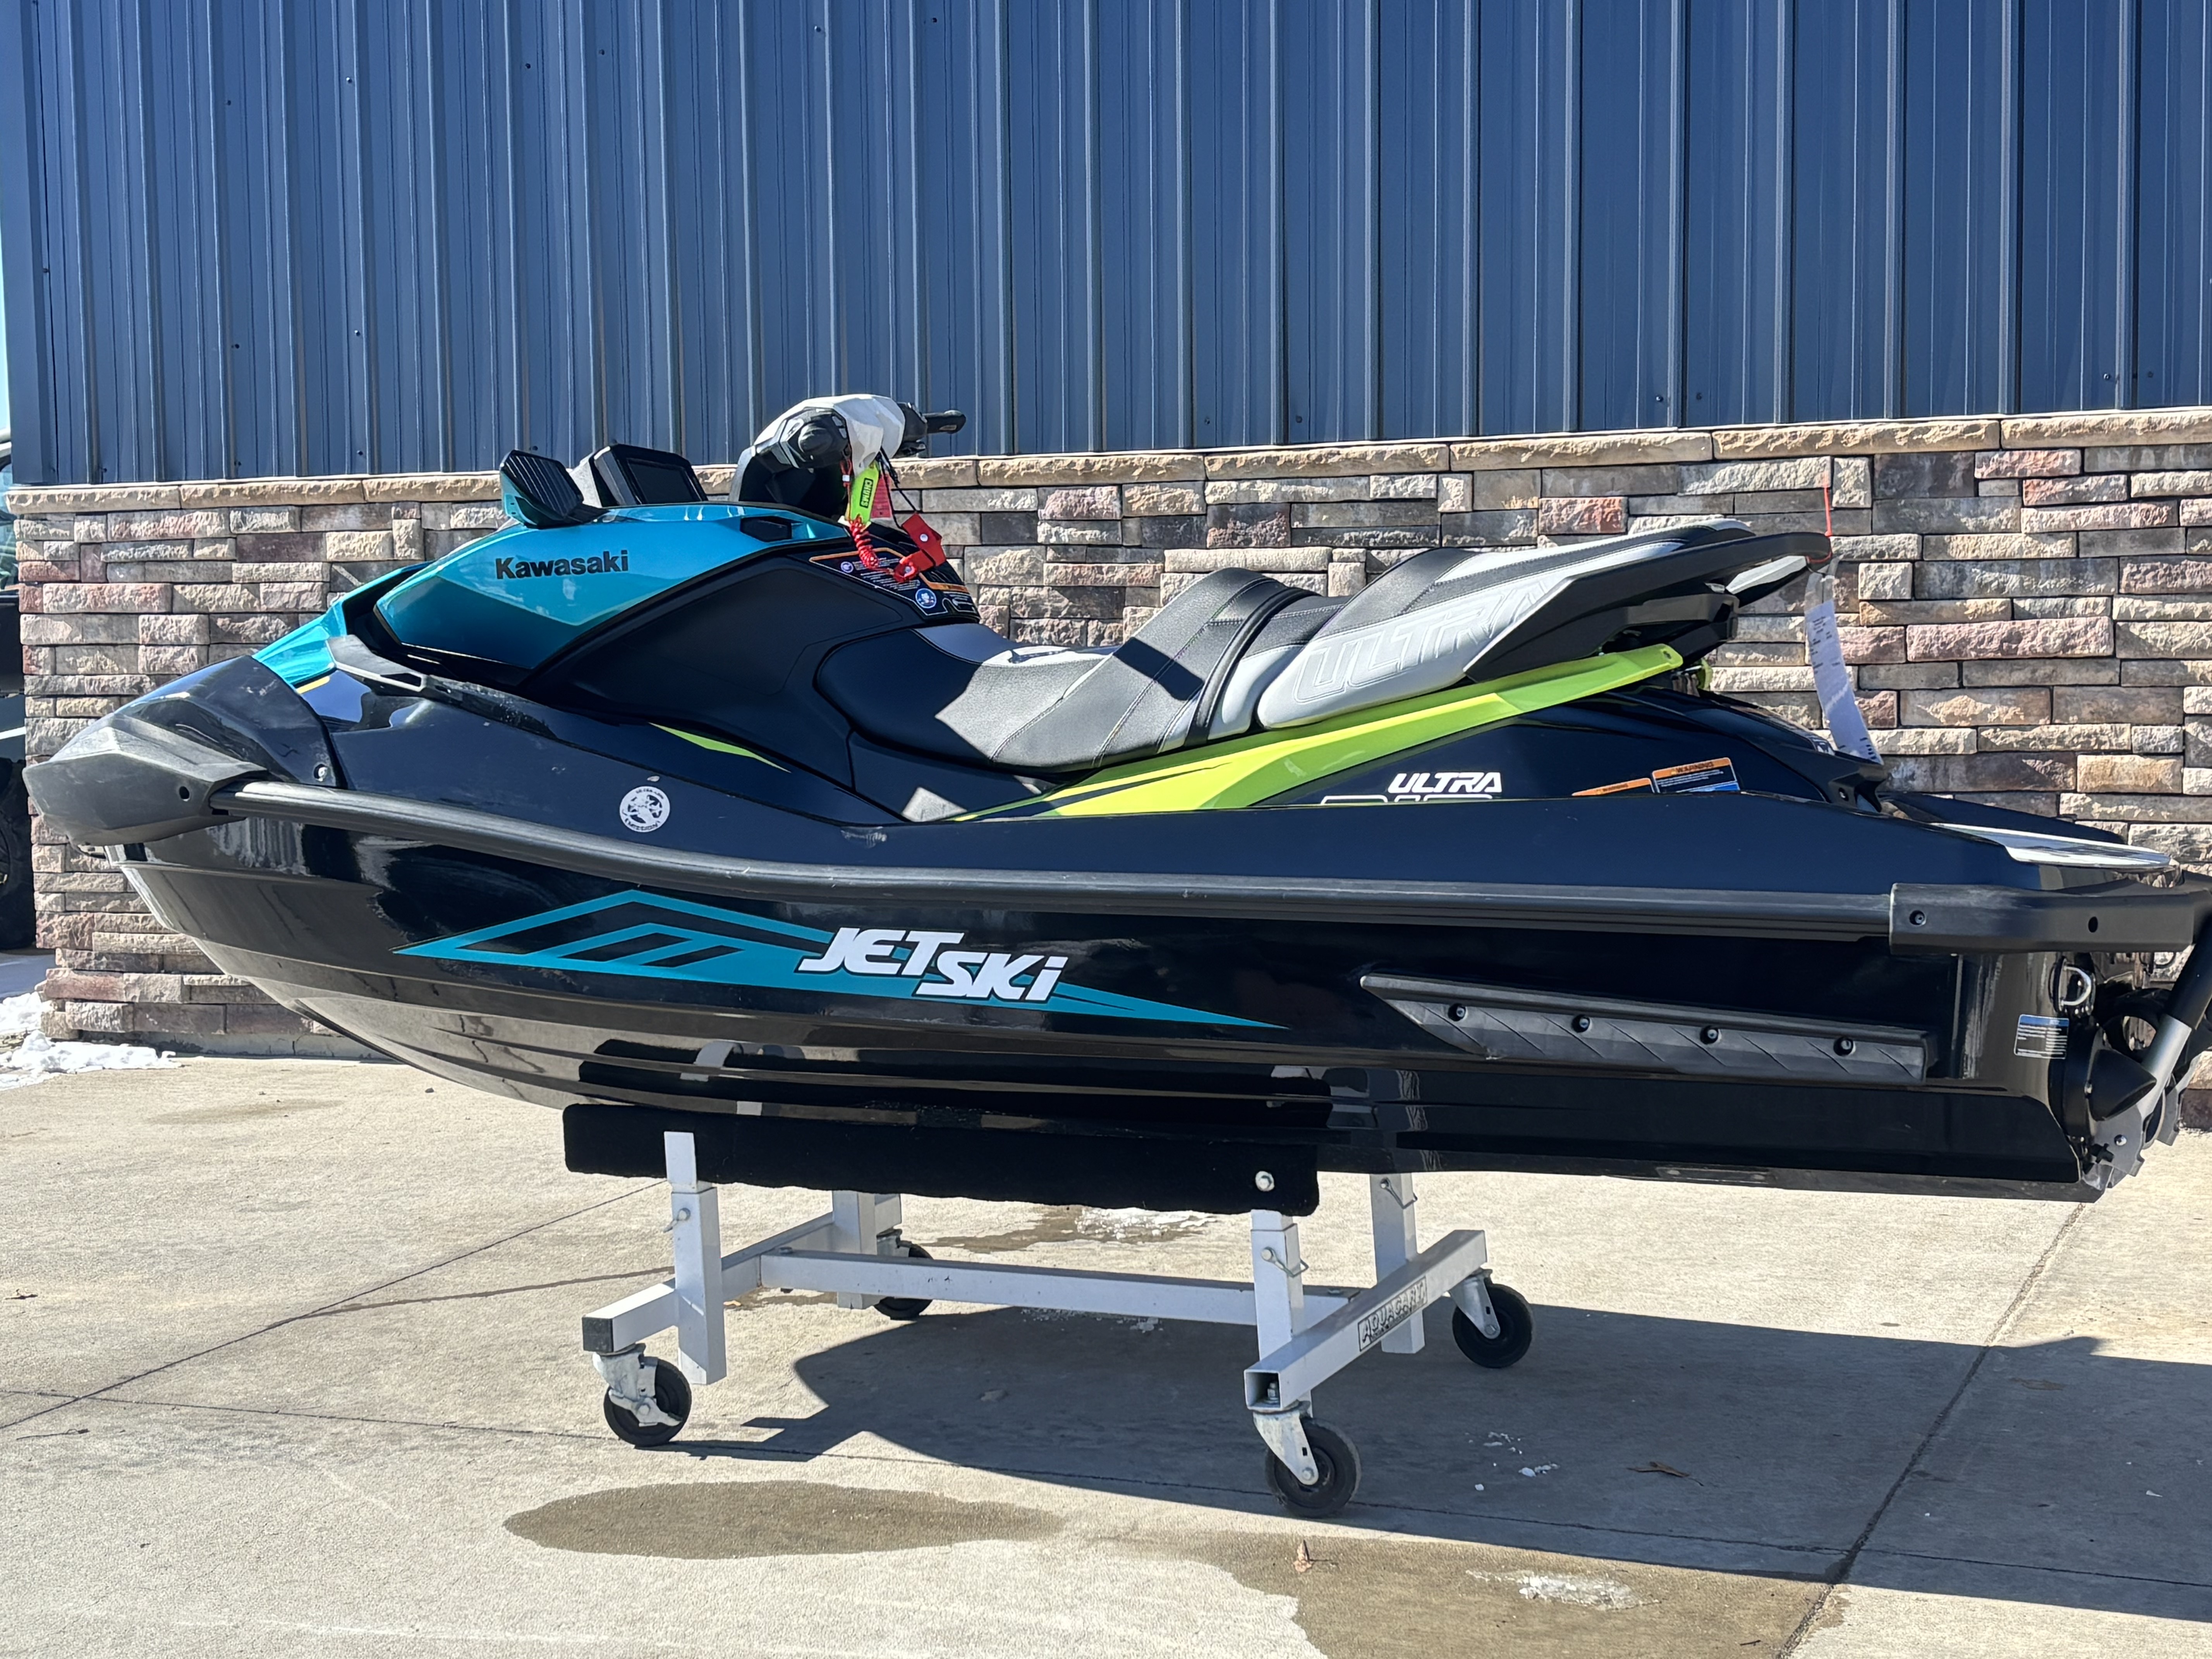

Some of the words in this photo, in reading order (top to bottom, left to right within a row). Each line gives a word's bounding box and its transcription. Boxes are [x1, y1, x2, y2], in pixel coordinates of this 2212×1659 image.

[860, 480, 873, 507] CHUMS
[496, 550, 629, 579] Kawasaki
[1388, 772, 1502, 793] ULTRA
